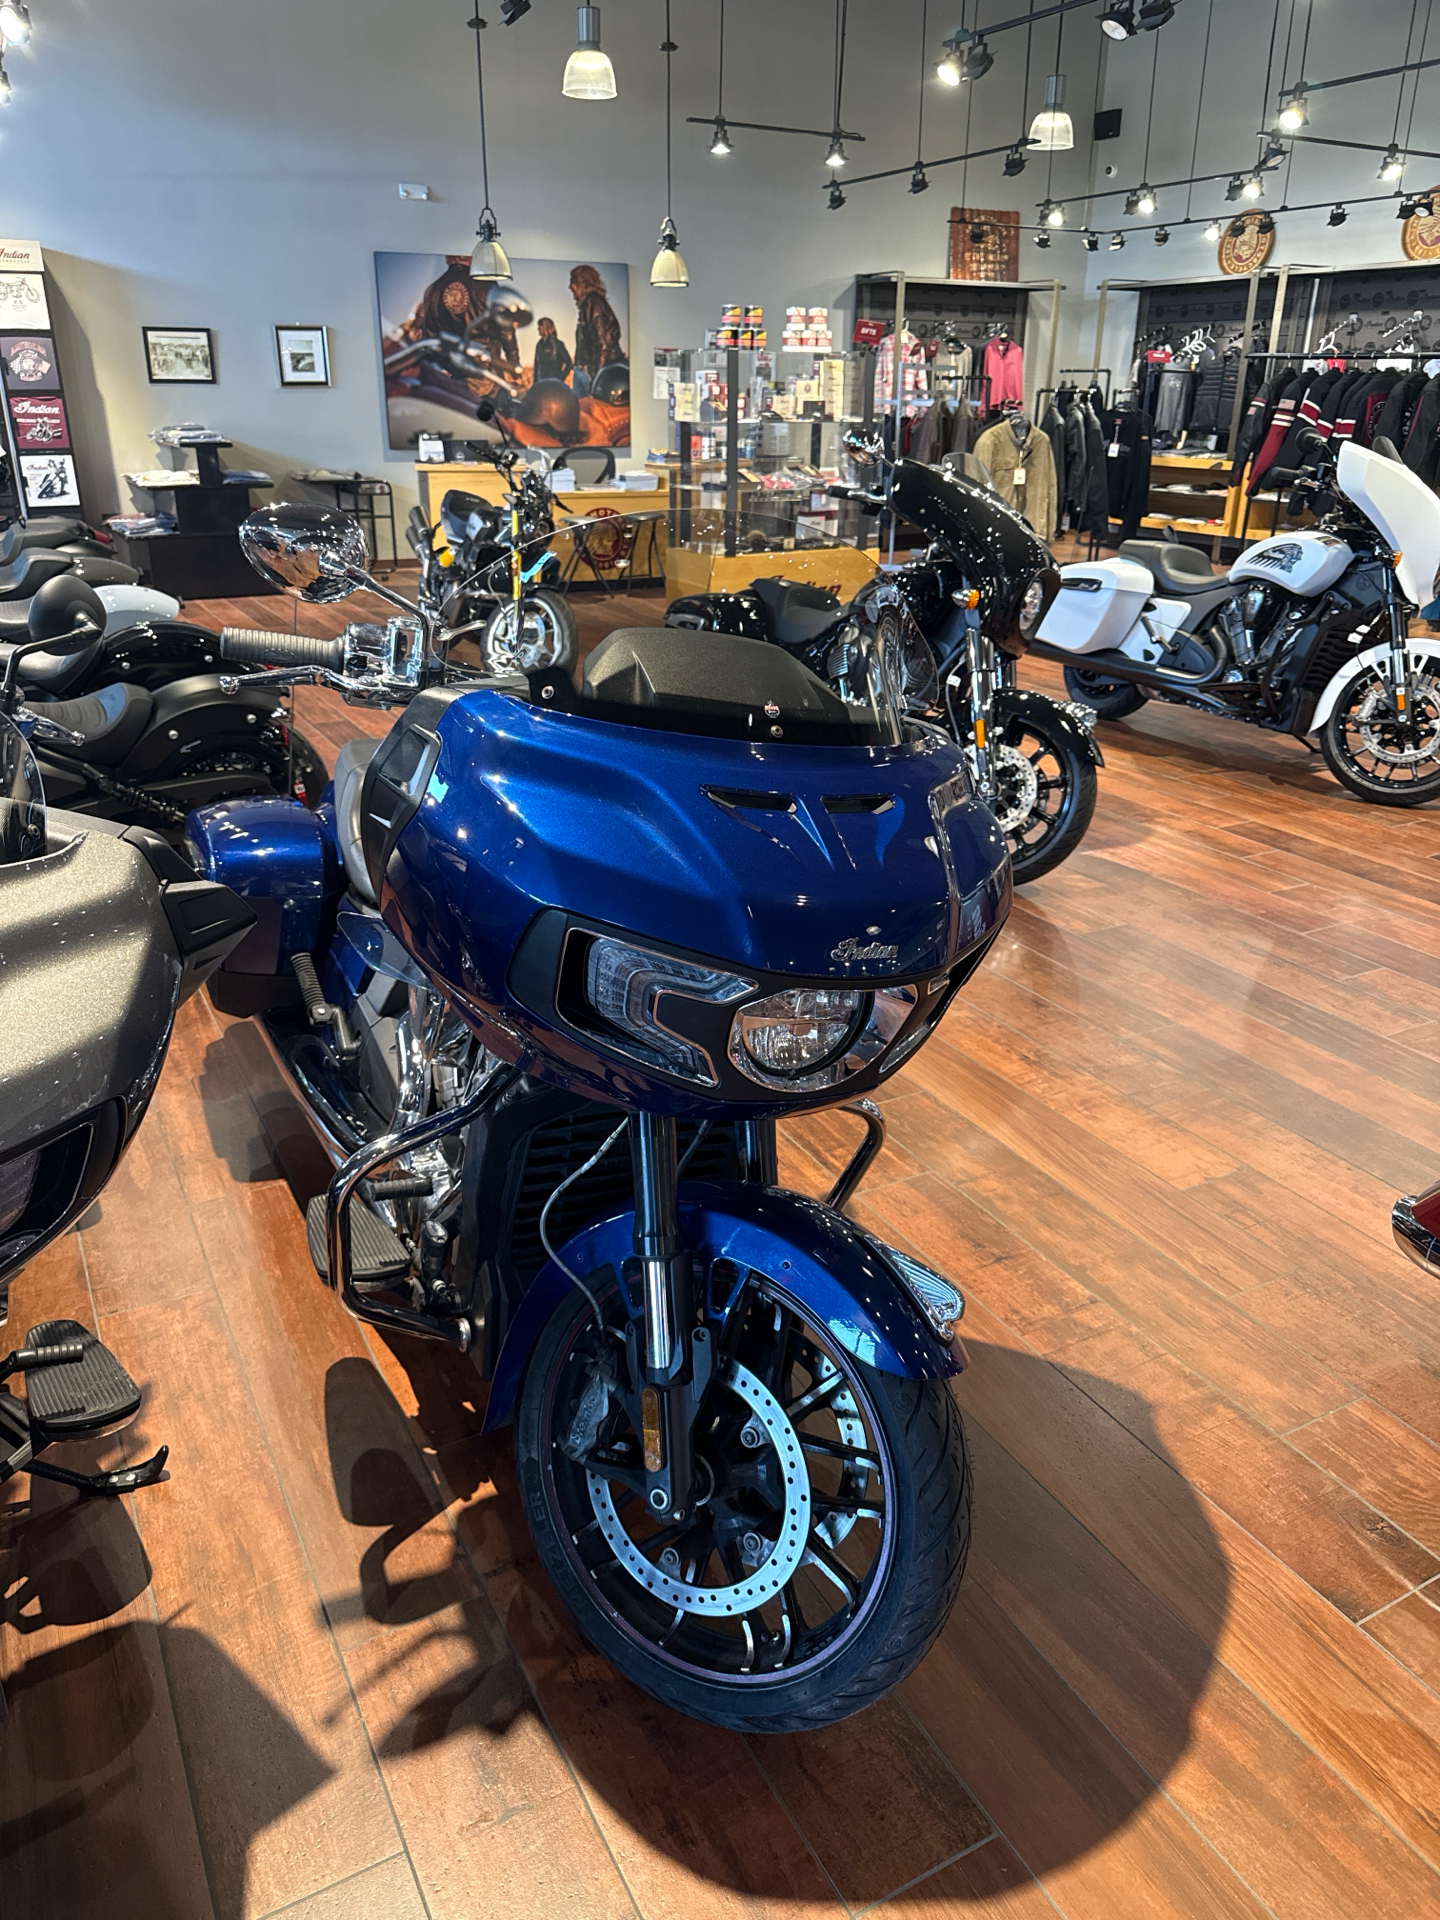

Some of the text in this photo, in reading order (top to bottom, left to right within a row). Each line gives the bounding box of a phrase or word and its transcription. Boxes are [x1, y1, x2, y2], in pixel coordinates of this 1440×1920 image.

[13, 400, 60, 414] Indian
[830, 936, 899, 961] Indian
[570, 1393, 598, 1445] brembo
[529, 1490, 588, 1607] METZELER
